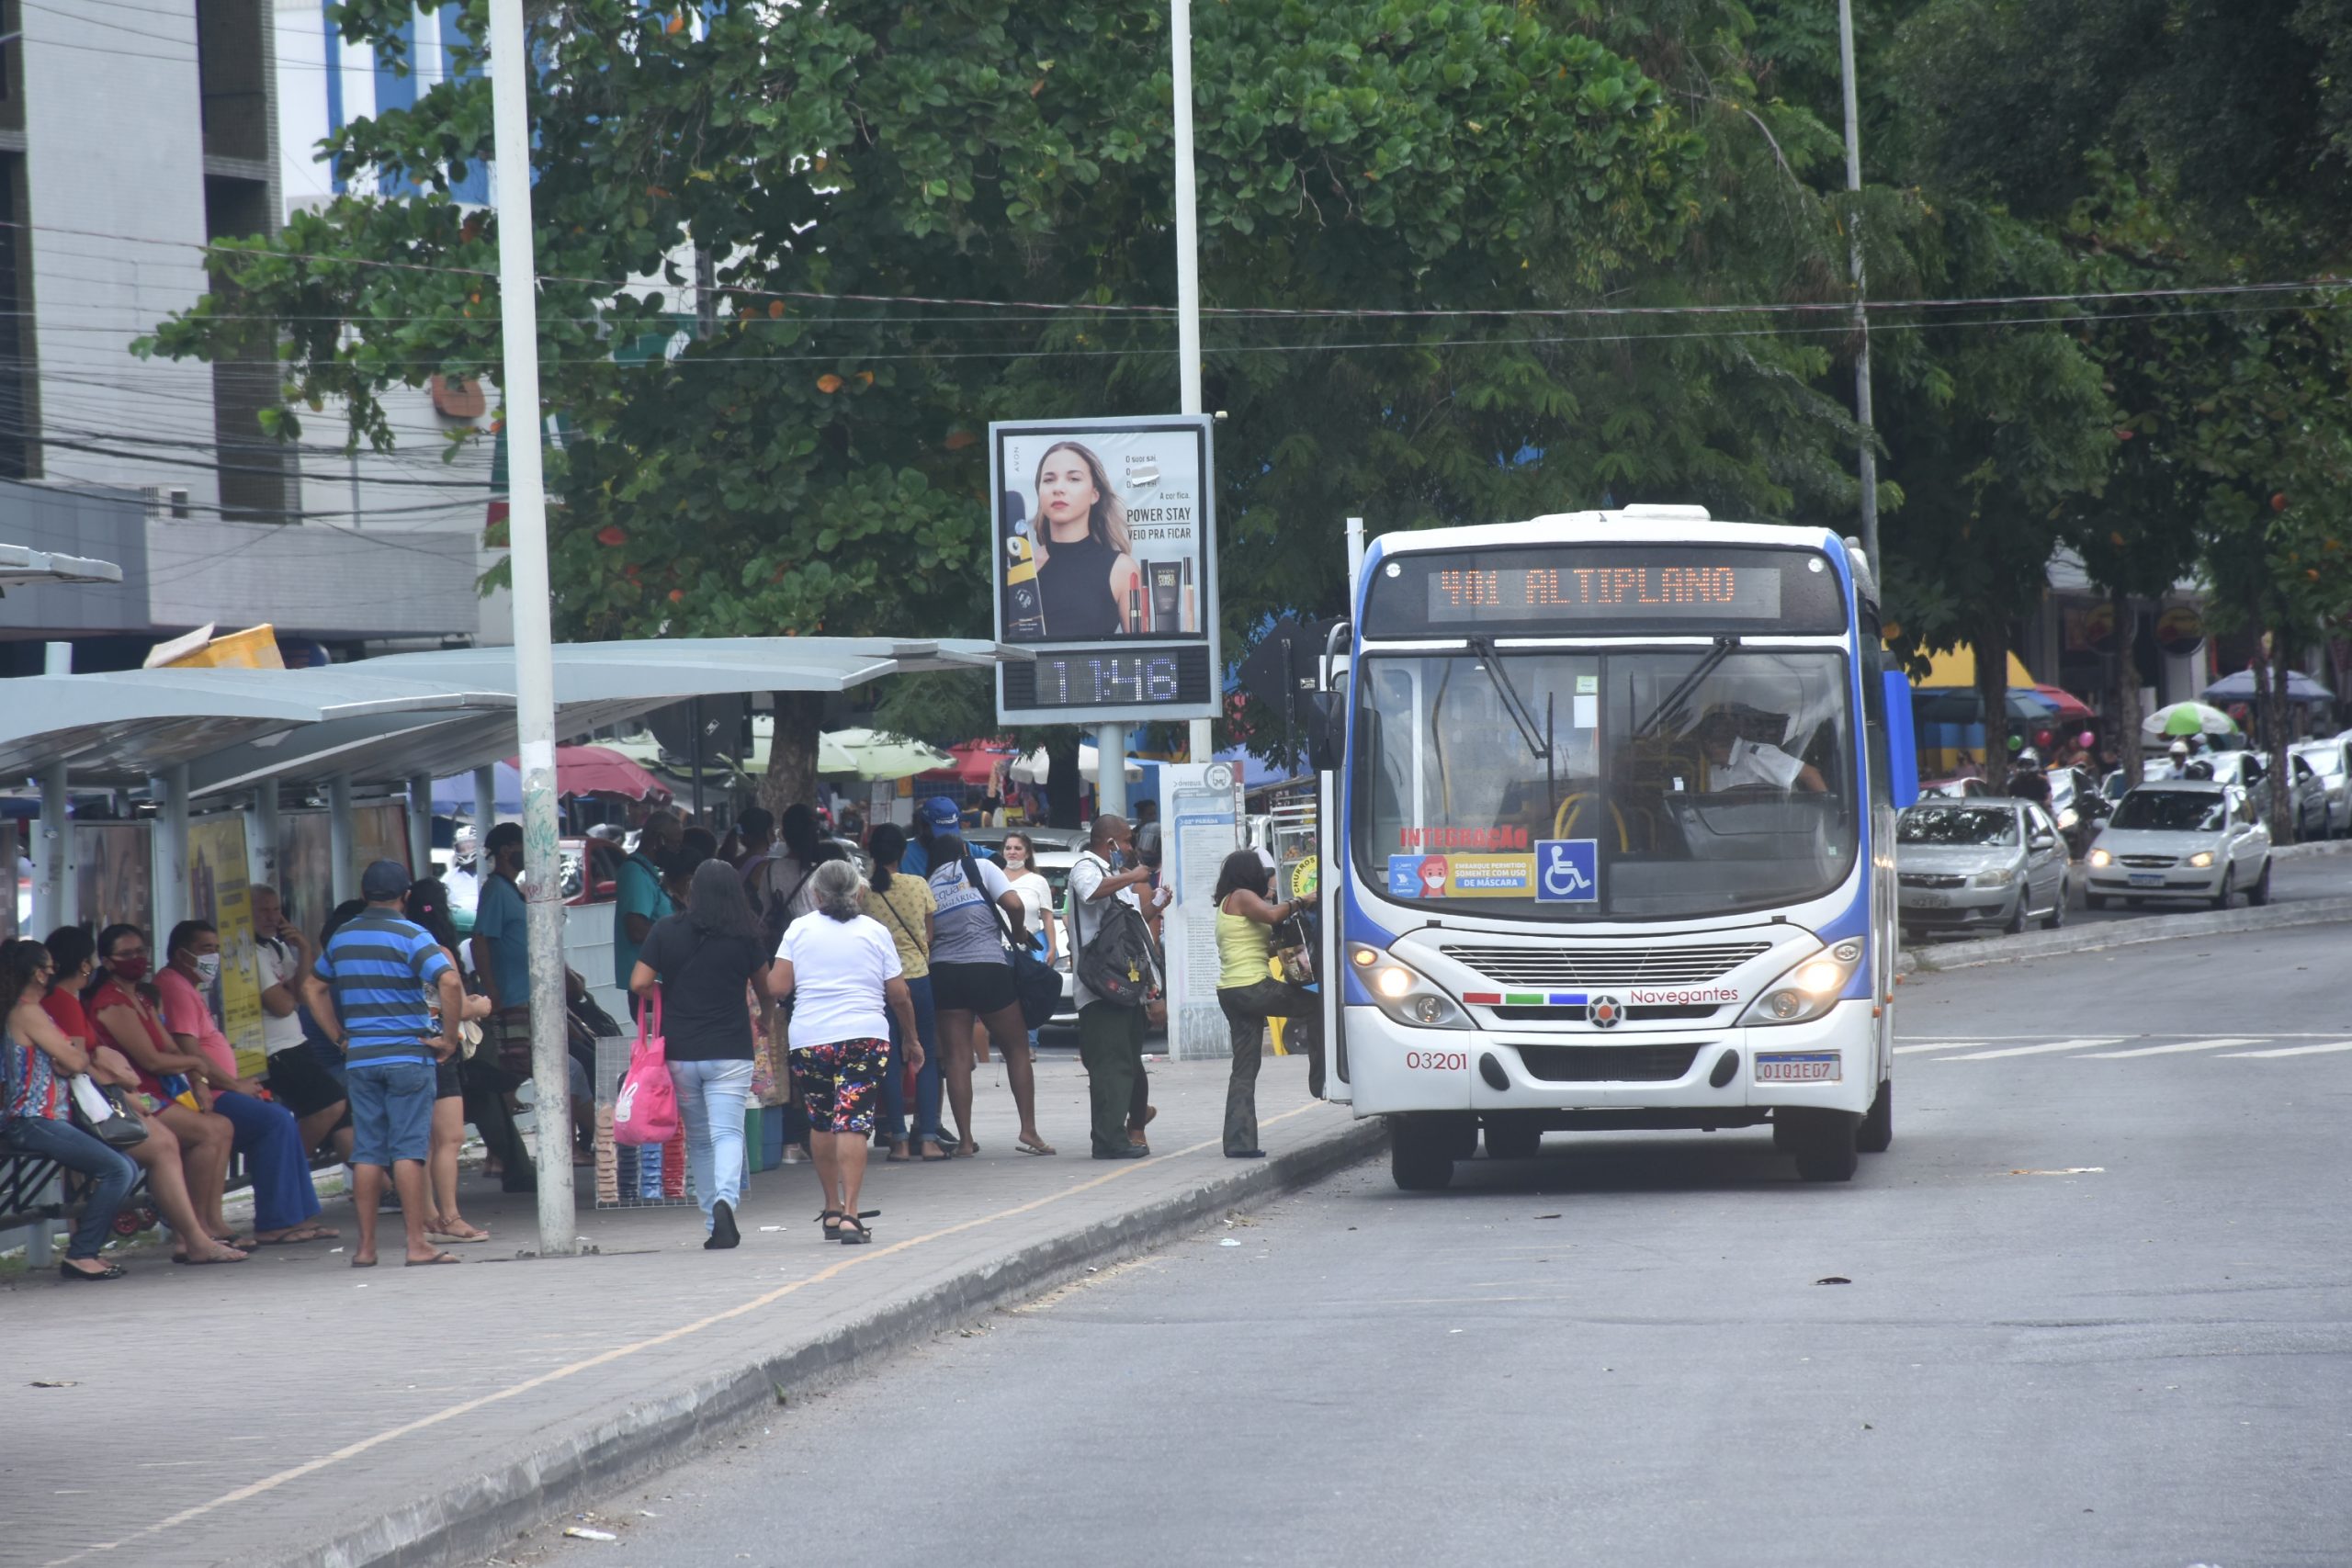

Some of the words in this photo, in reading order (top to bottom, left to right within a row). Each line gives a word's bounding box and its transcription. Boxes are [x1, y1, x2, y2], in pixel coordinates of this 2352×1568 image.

[1159, 491, 1164, 500] A
[1126, 508, 1163, 523] POWER
[1166, 507, 1191, 521] STAY
[1127, 529, 1146, 540] VEIO
[1148, 528, 1165, 539] PRA
[1168, 527, 1192, 539] FICAR
[1442, 570, 1499, 605] 401
[1526, 567, 1735, 604] ALTIPLANO
[1054, 658, 1177, 703] 11:46
[1400, 825, 1528, 851] INTEGRAÇÃO
[1293, 857, 1315, 893] CHURROS
[1477, 877, 1518, 886] MÁSCARA
[1631, 987, 1738, 1005] Navegantes
[1407, 1052, 1466, 1070] 03201
